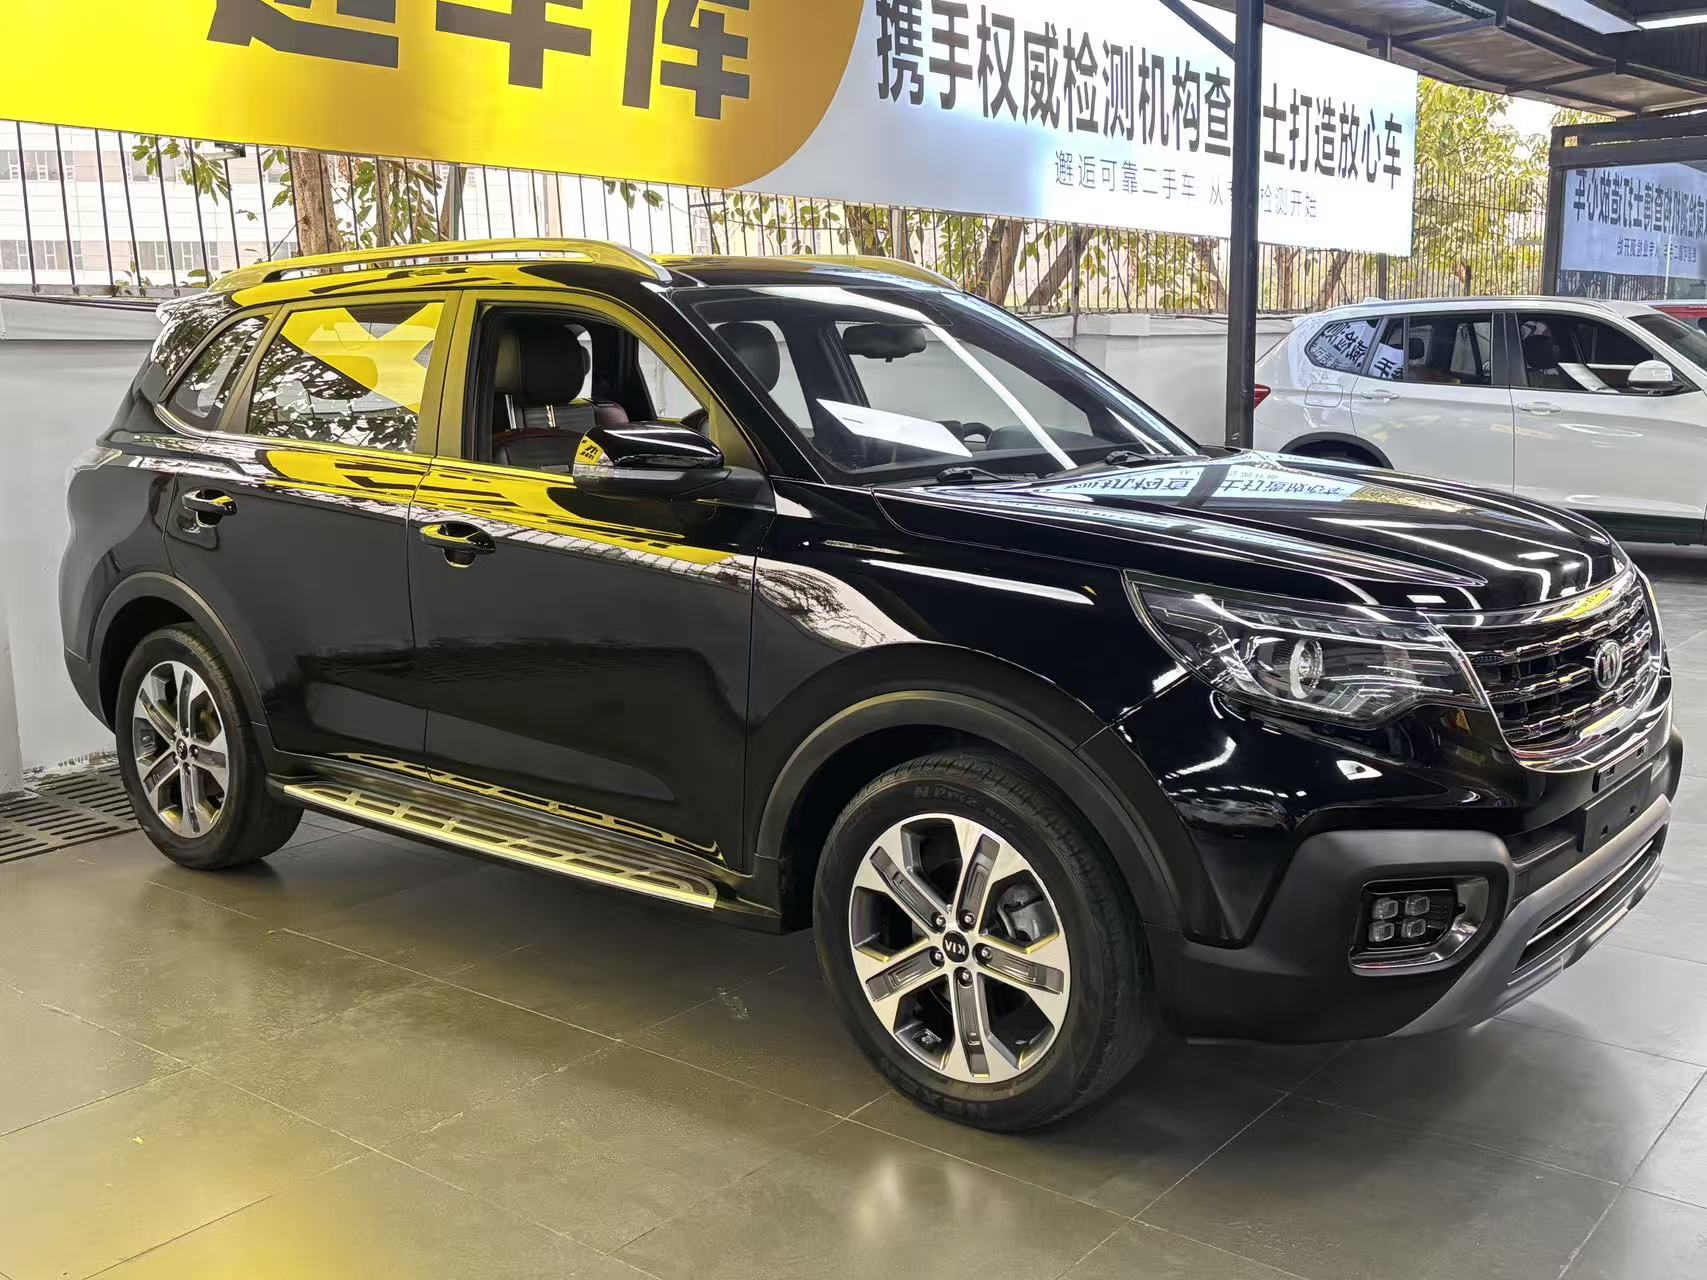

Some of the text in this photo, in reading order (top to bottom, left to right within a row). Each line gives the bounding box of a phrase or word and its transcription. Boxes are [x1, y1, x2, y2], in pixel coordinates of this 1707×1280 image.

[876, 0, 1402, 190] 携手权威检测机构查士打造放心车
[1055, 150, 1196, 203] 邂逅可靠二手车
[944, 939, 966, 956] KIA
